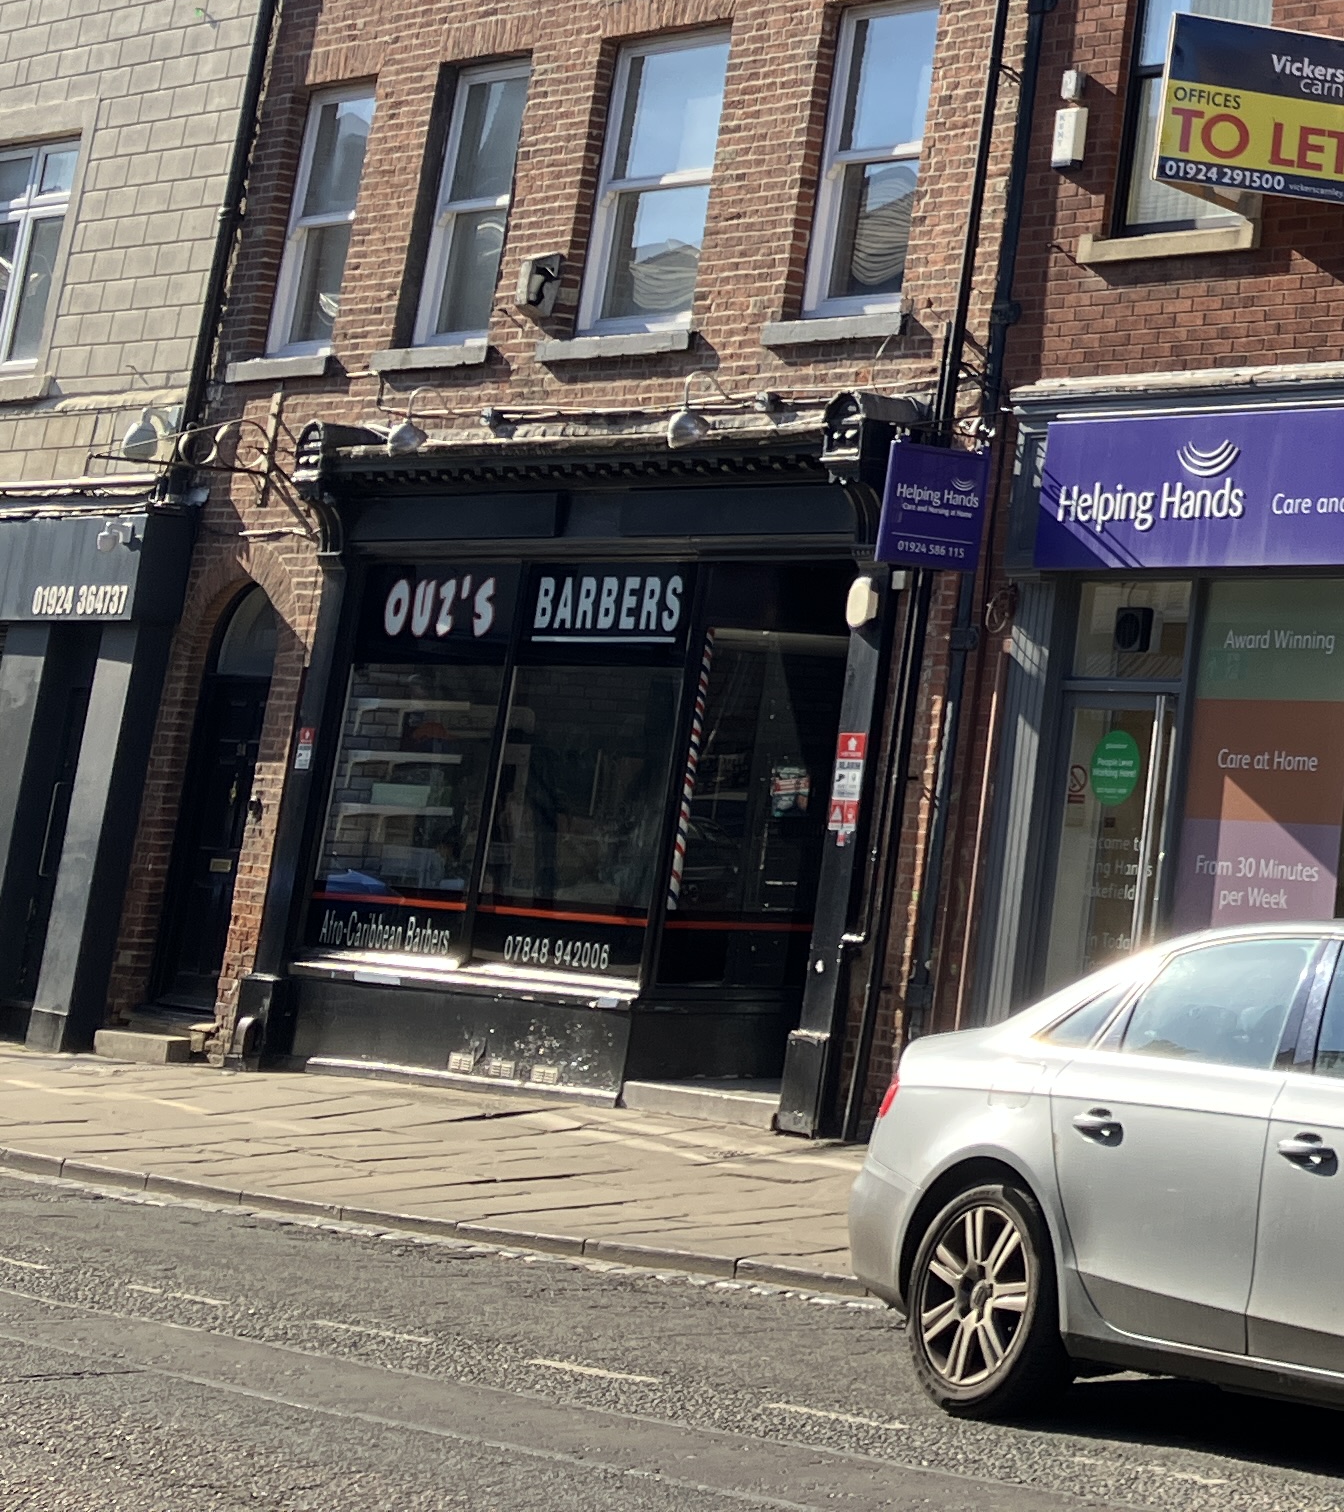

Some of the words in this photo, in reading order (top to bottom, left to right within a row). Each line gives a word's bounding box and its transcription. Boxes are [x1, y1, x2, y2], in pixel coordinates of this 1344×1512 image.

[1271, 53, 1344, 82] Vickers
[1174, 86, 1241, 110] OFFICES
[1171, 106, 1250, 159] TO
[1164, 160, 1219, 183] 01924
[1221, 167, 1285, 190] 291500
[896, 482, 941, 507] Helping
[943, 490, 979, 508] Hands
[1056, 481, 1154, 531] Helping
[1158, 477, 1245, 520] Hands
[1271, 492, 1312, 515] Care
[897, 540, 927, 554] 01924
[928, 544, 946, 556] 586
[948, 547, 965, 559] 115
[31, 585, 75, 615] 01924
[76, 584, 129, 615] 364737
[384, 573, 496, 637] OUZ'S
[533, 575, 684, 632] BARBERS
[1223, 629, 1271, 650] Award
[1273, 630, 1336, 655] Winning
[1217, 748, 1251, 770] Care
[1253, 752, 1270, 770] at
[1273, 751, 1319, 772] Home
[1195, 855, 1233, 876] From
[1235, 857, 1257, 878] 30
[1258, 859, 1319, 882] Minutes
[1218, 889, 1244, 910] per
[1247, 887, 1288, 910] Week
[319, 910, 403, 950] Afro-Caribbean
[404, 916, 450, 955] Barbers
[503, 935, 550, 964] 07848
[553, 939, 610, 970] 942006
